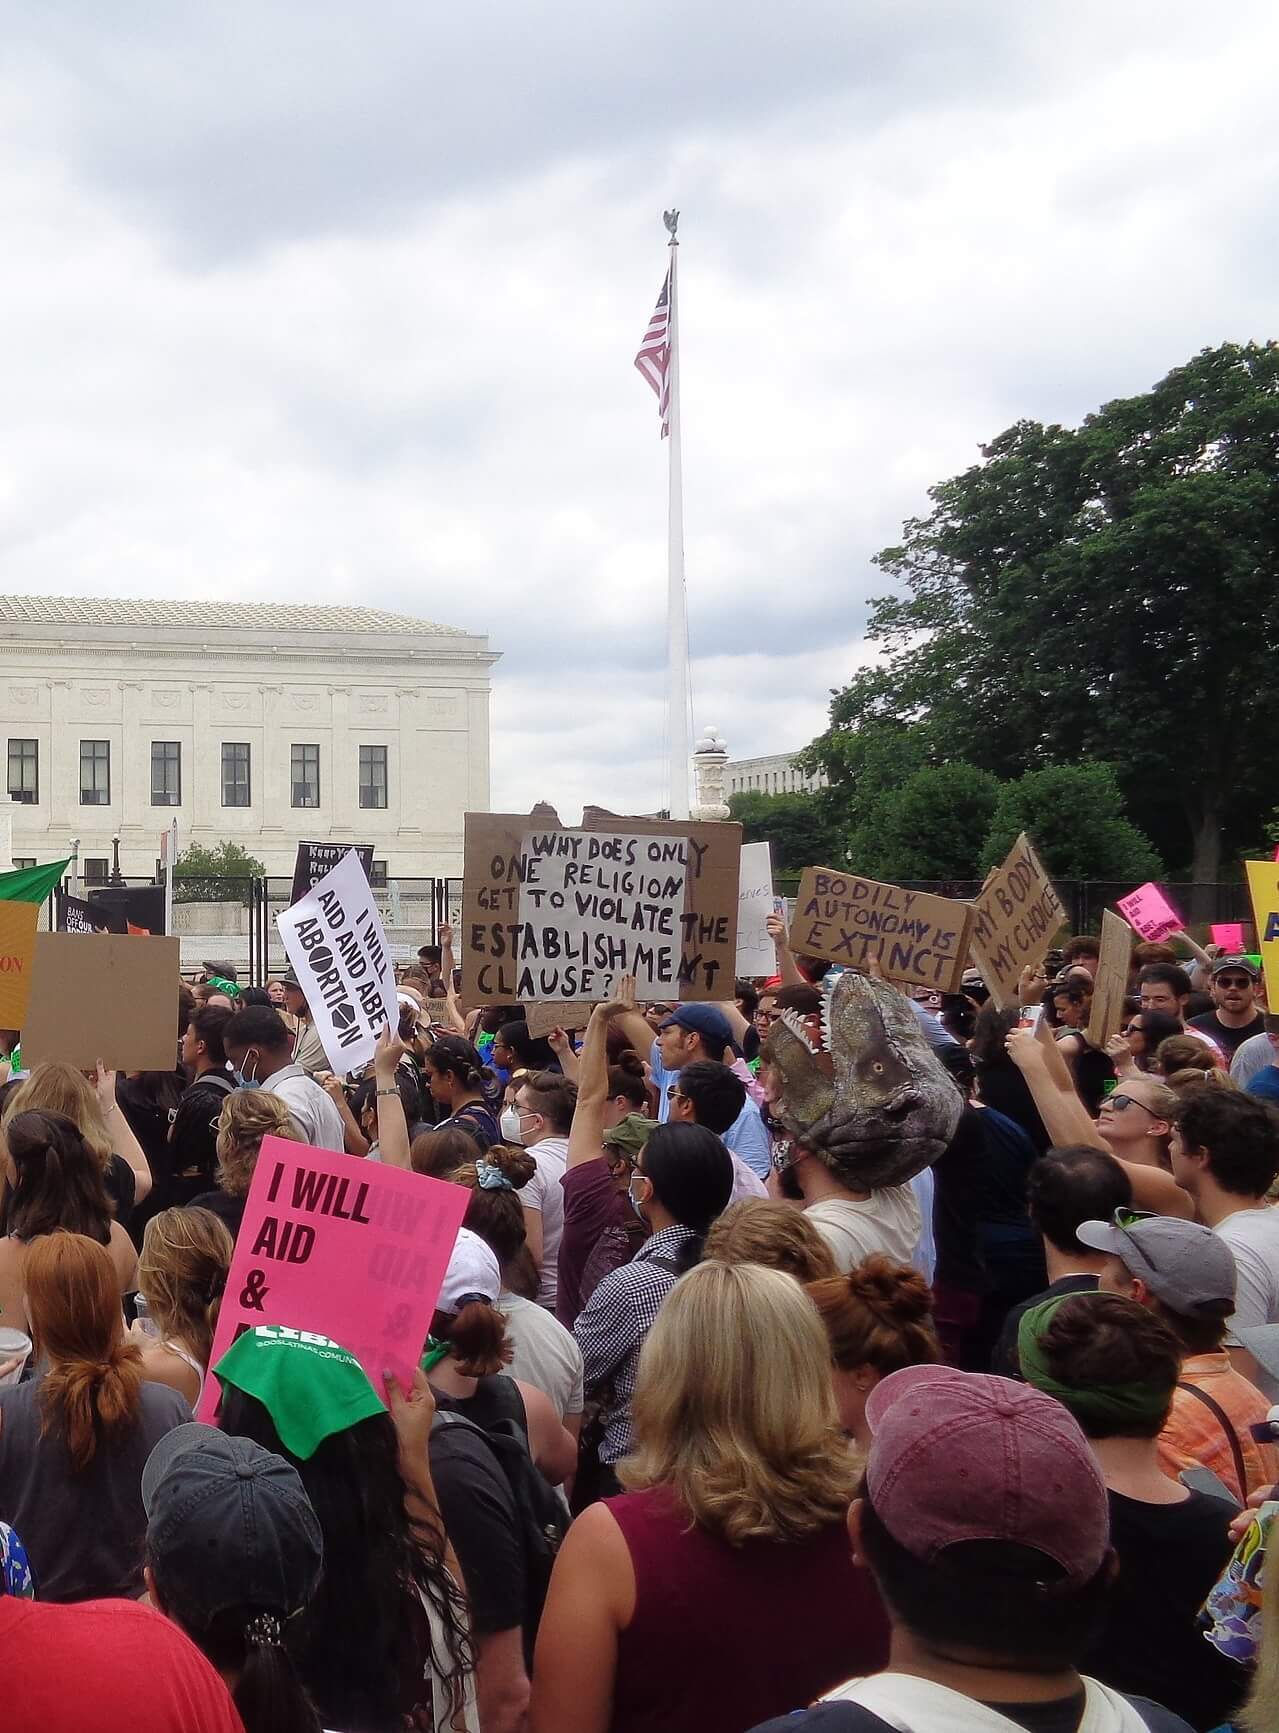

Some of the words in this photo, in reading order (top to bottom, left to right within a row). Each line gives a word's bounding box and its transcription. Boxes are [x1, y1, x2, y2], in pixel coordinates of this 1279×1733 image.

[490, 853, 544, 884] ONE
[564, 862, 684, 900] RELIGION
[532, 832, 582, 859] WHY
[588, 837, 638, 866] DOES
[647, 838, 709, 878] ONLY
[67, 906, 84, 920] BANS
[477, 886, 516, 911] GET
[526, 888, 565, 909] TO
[574, 890, 673, 935] VIOLATE
[679, 911, 729, 945] THE
[815, 874, 917, 914] BODILY
[974, 900, 999, 949] MY
[995, 846, 1040, 918] BODY
[66, 916, 79, 928] OFF
[79, 920, 93, 933] OUR
[356, 908, 368, 925] I
[363, 921, 388, 985] WILL
[803, 897, 931, 943] AUTONOMY
[932, 928, 956, 951] IS
[806, 921, 957, 982] EXTINCT
[989, 935, 1017, 984] MY
[1014, 883, 1060, 951] CHOICE
[294, 917, 363, 1049] ABORTION
[318, 889, 345, 930] AID
[335, 930, 367, 979] AND
[355, 980, 388, 1040] ABE
[470, 921, 721, 991] ESTABLISHMENT
[266, 1162, 285, 1203] I
[291, 1167, 371, 1224] WILL
[251, 1216, 316, 1265] AID
[239, 1269, 271, 1312] &
